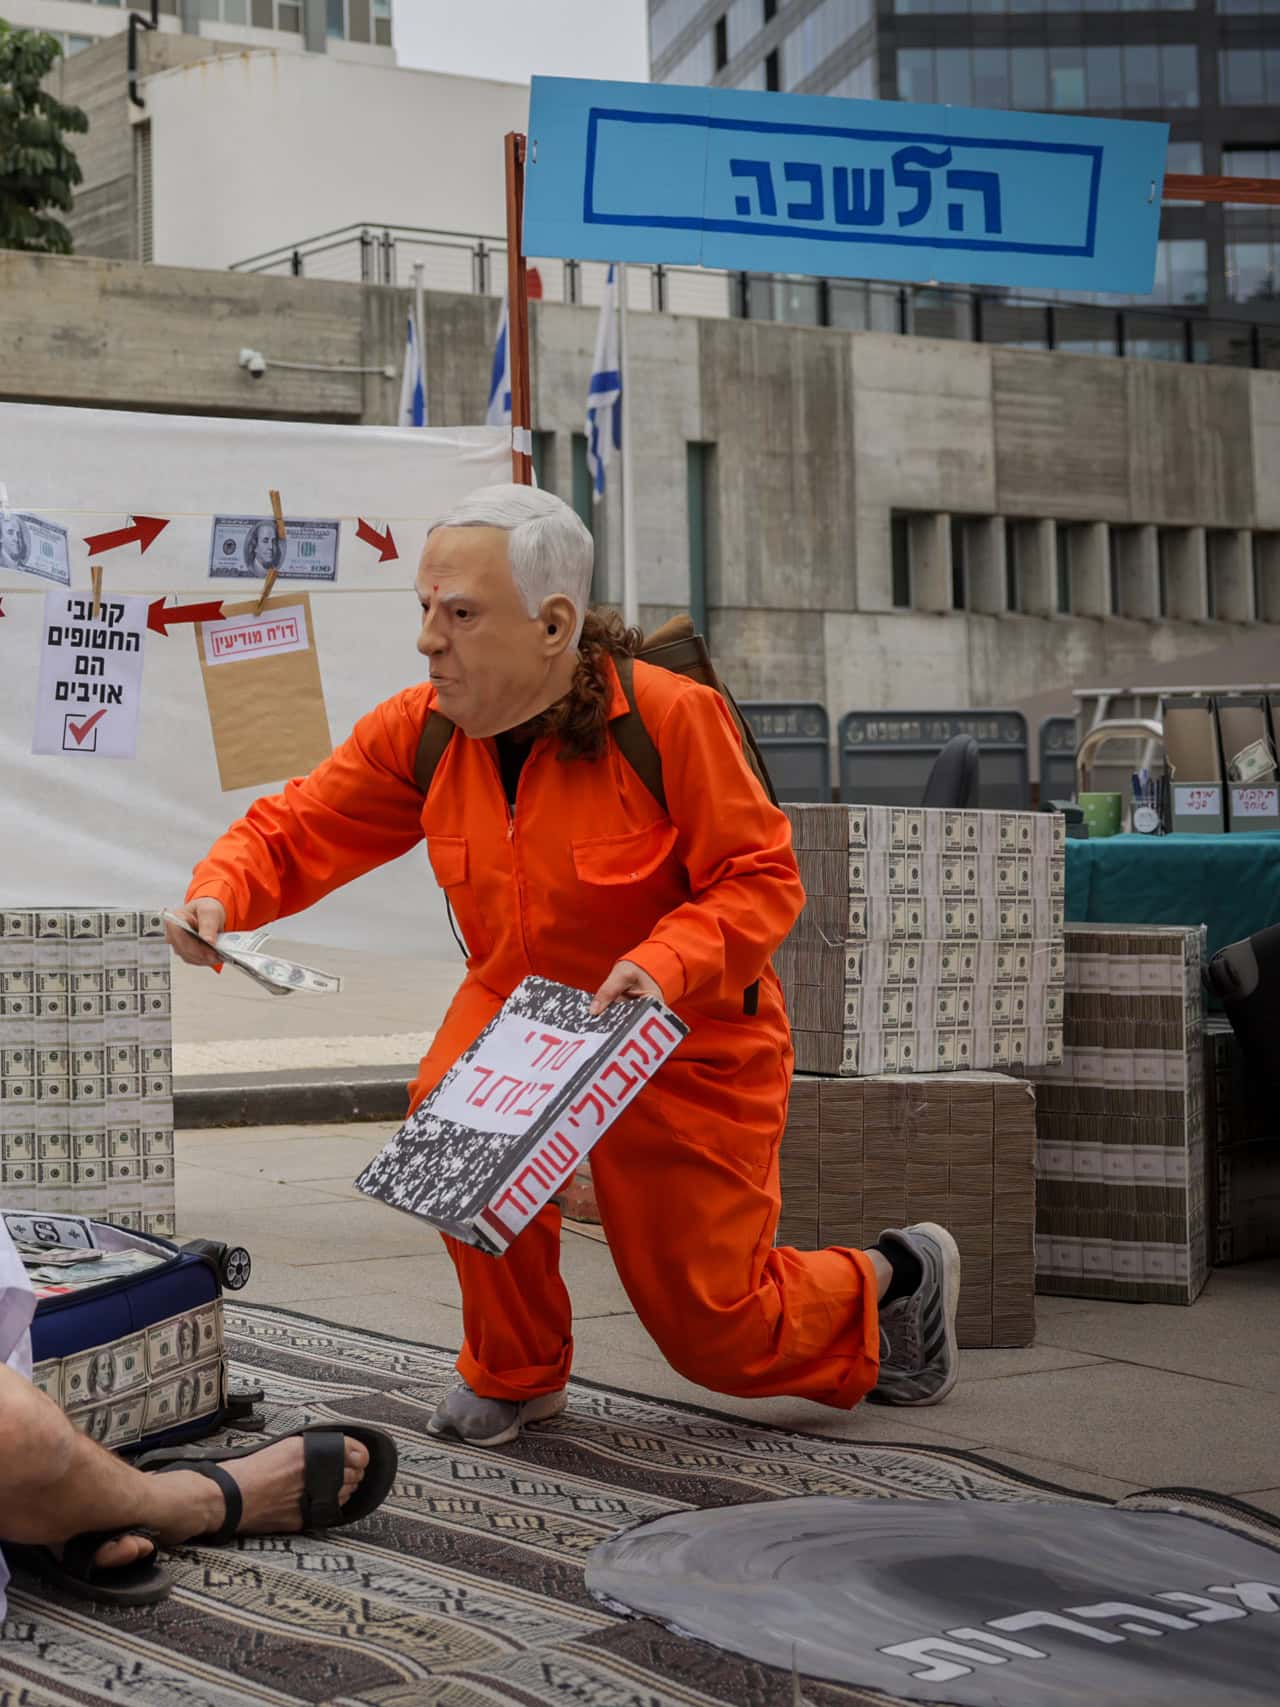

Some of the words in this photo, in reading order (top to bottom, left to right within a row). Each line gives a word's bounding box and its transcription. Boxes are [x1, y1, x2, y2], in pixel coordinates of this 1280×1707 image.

[729, 144, 1003, 235] הלשכה
[66, 599, 125, 628] קרובי
[47, 625, 140, 652] החטופים
[214, 630, 263, 653] מודיעין
[74, 655, 105, 676] הם
[55, 680, 123, 705] אויבים
[524, 1031, 586, 1072] סודי
[568, 1015, 676, 1128] תקבולי
[465, 1065, 555, 1117] ביותר
[492, 1130, 580, 1217] שוחד
